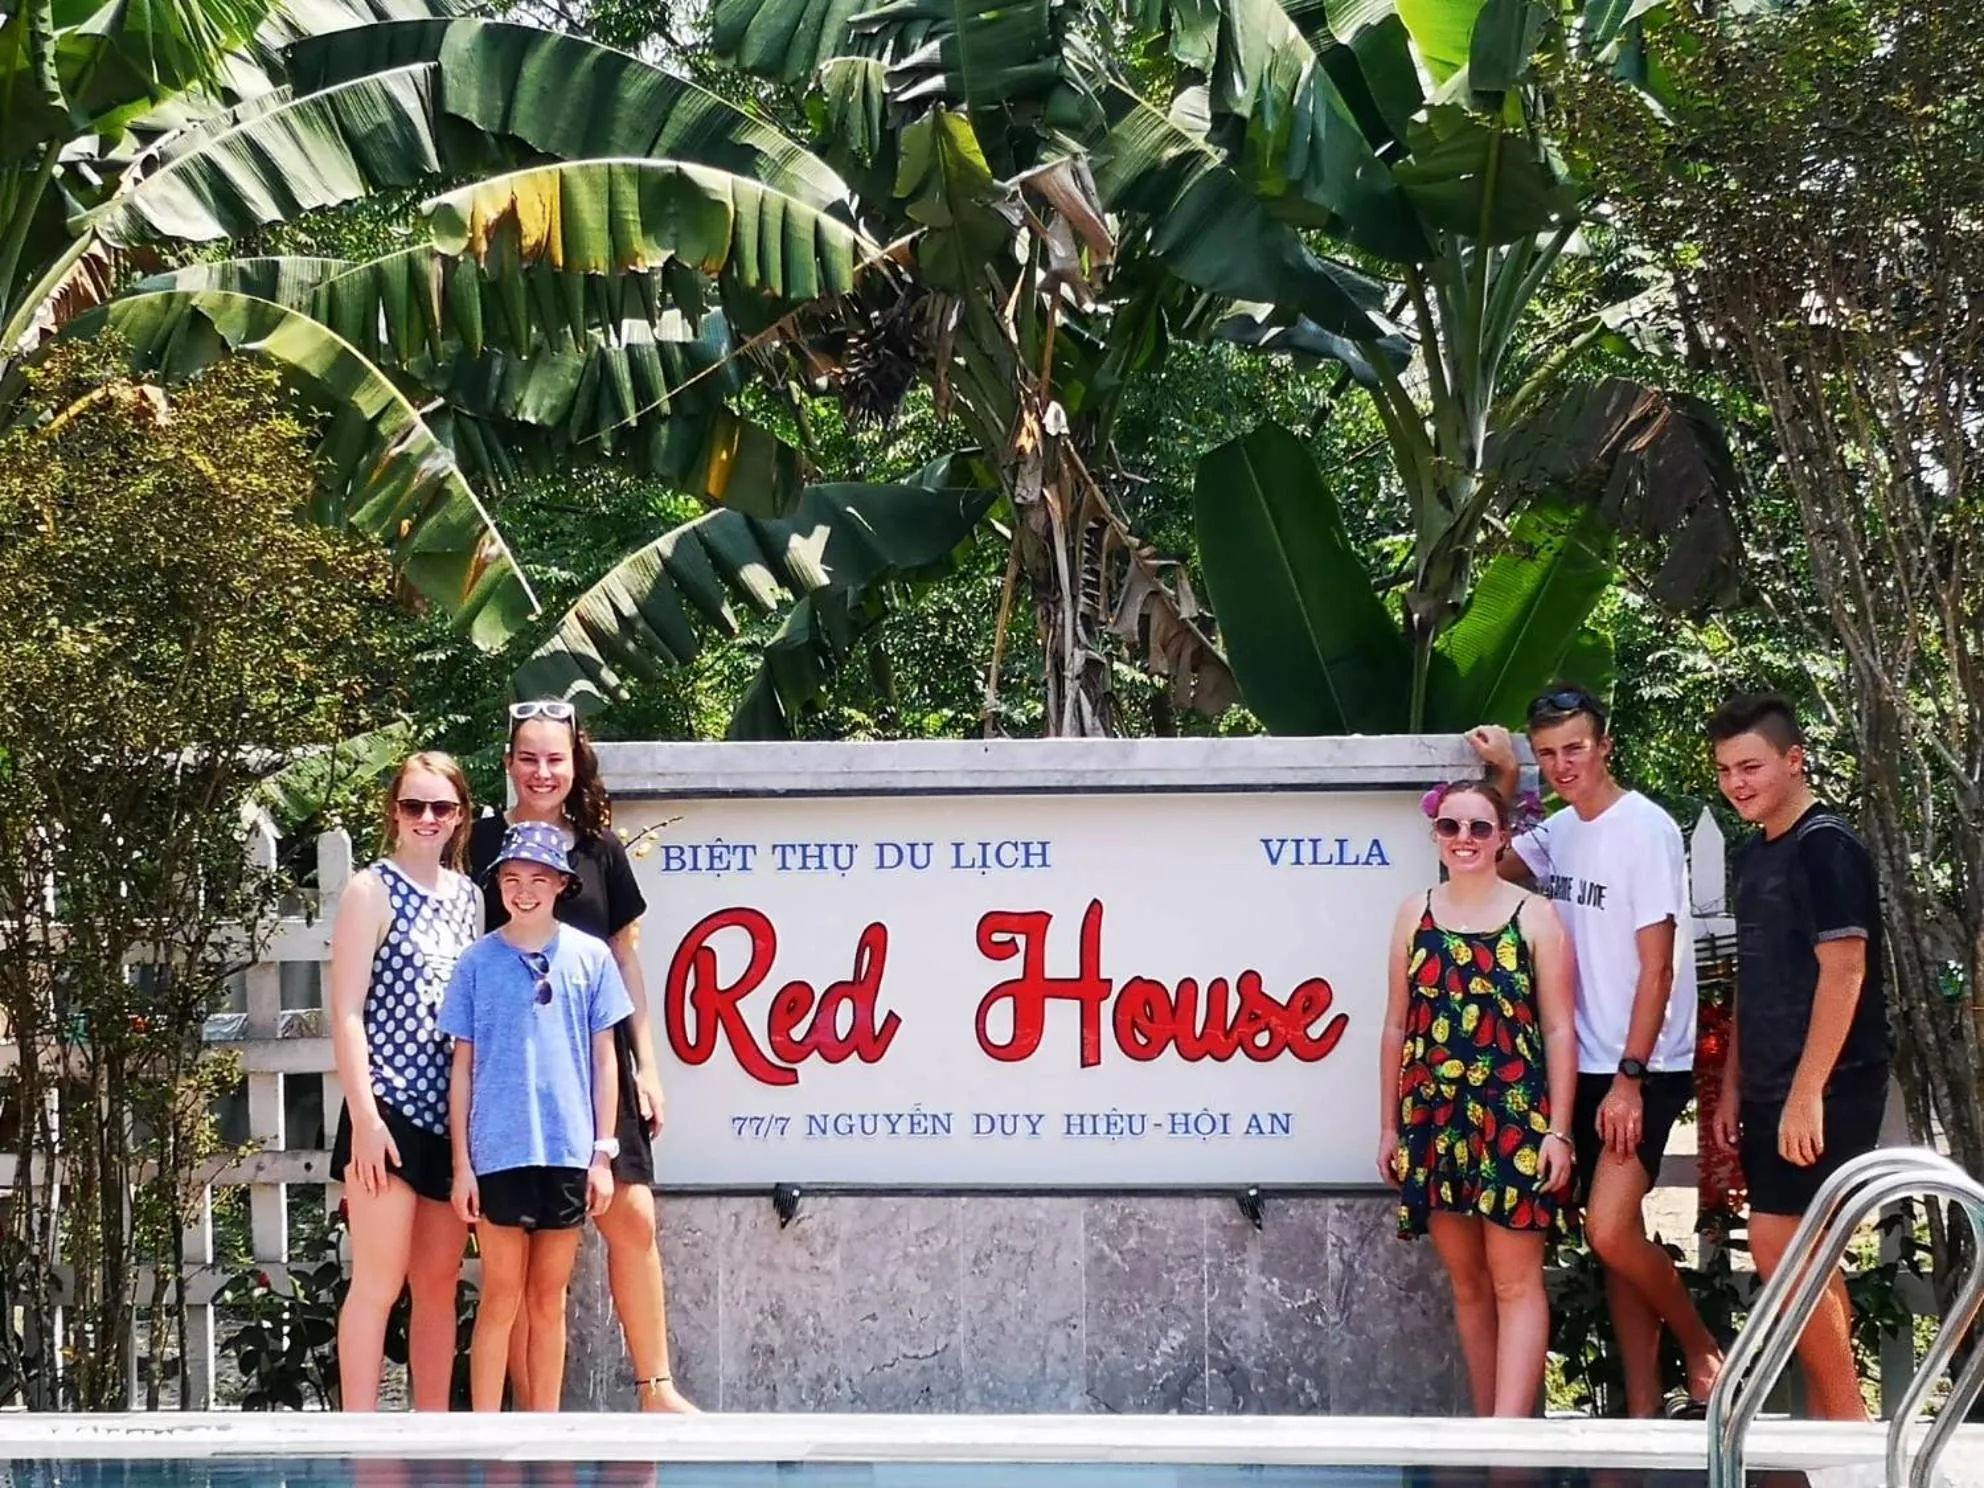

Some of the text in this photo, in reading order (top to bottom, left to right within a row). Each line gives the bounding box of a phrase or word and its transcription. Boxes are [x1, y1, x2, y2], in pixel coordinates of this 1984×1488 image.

[661, 837, 1052, 877] BIỆT THỰ DU LỊCH
[1259, 838, 1391, 866] VILLA
[664, 897, 1350, 1087] Red House
[731, 1112, 792, 1138] 77/7
[972, 1113, 1046, 1136] DUY
[1243, 1112, 1293, 1136] AN
